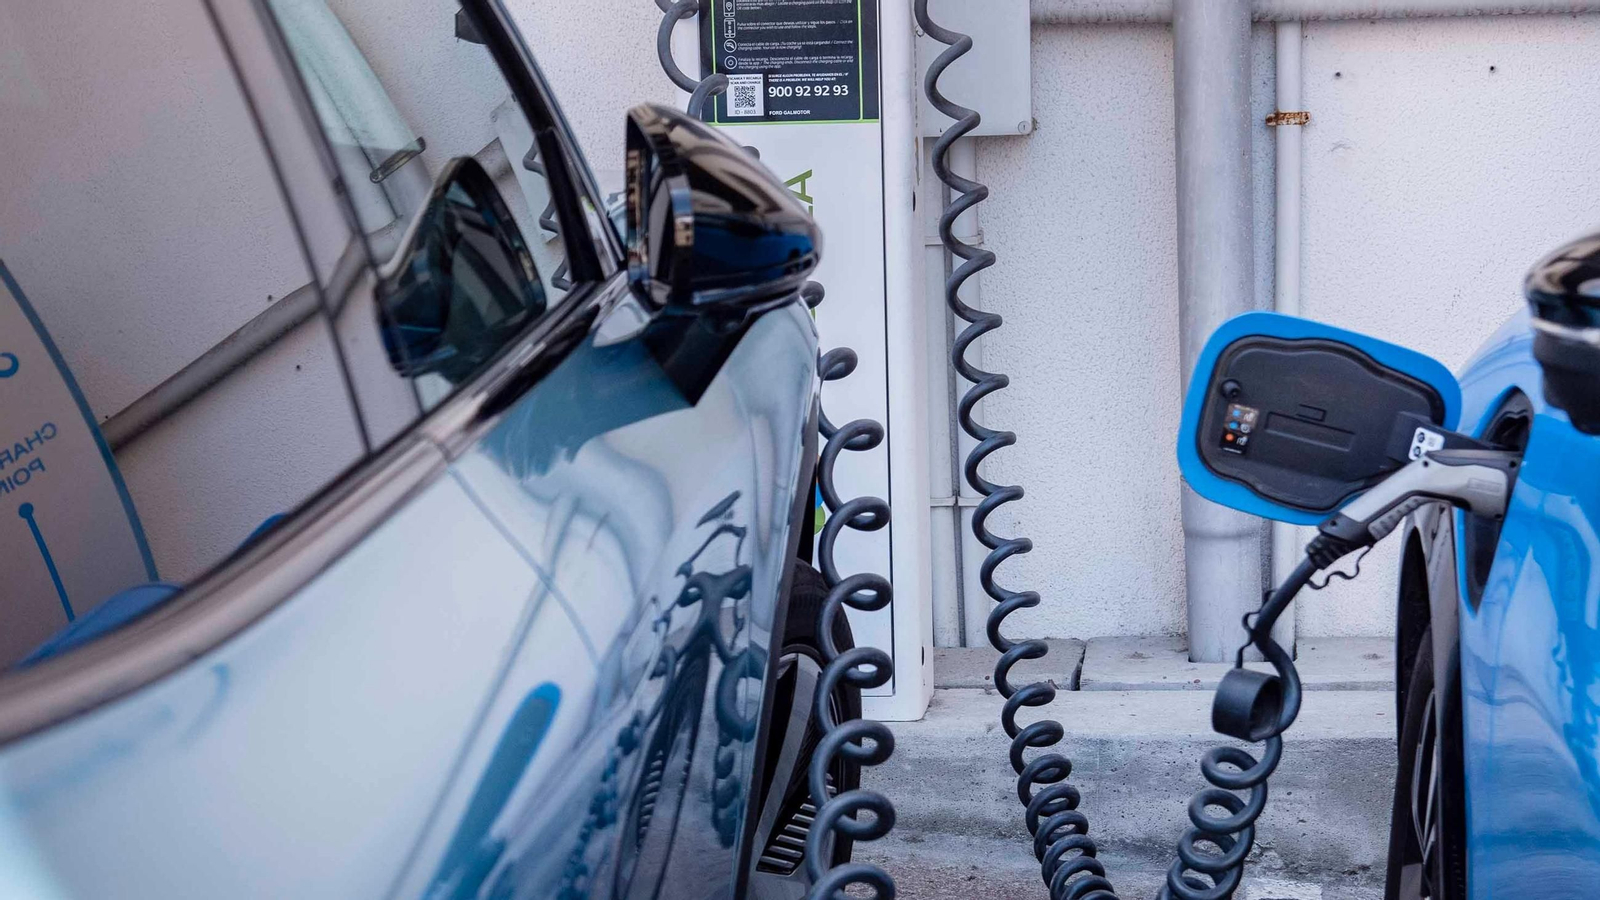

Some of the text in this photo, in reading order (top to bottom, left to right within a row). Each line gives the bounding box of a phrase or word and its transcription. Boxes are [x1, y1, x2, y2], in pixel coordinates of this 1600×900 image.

[768, 85, 848, 97] 900 92 92 93
